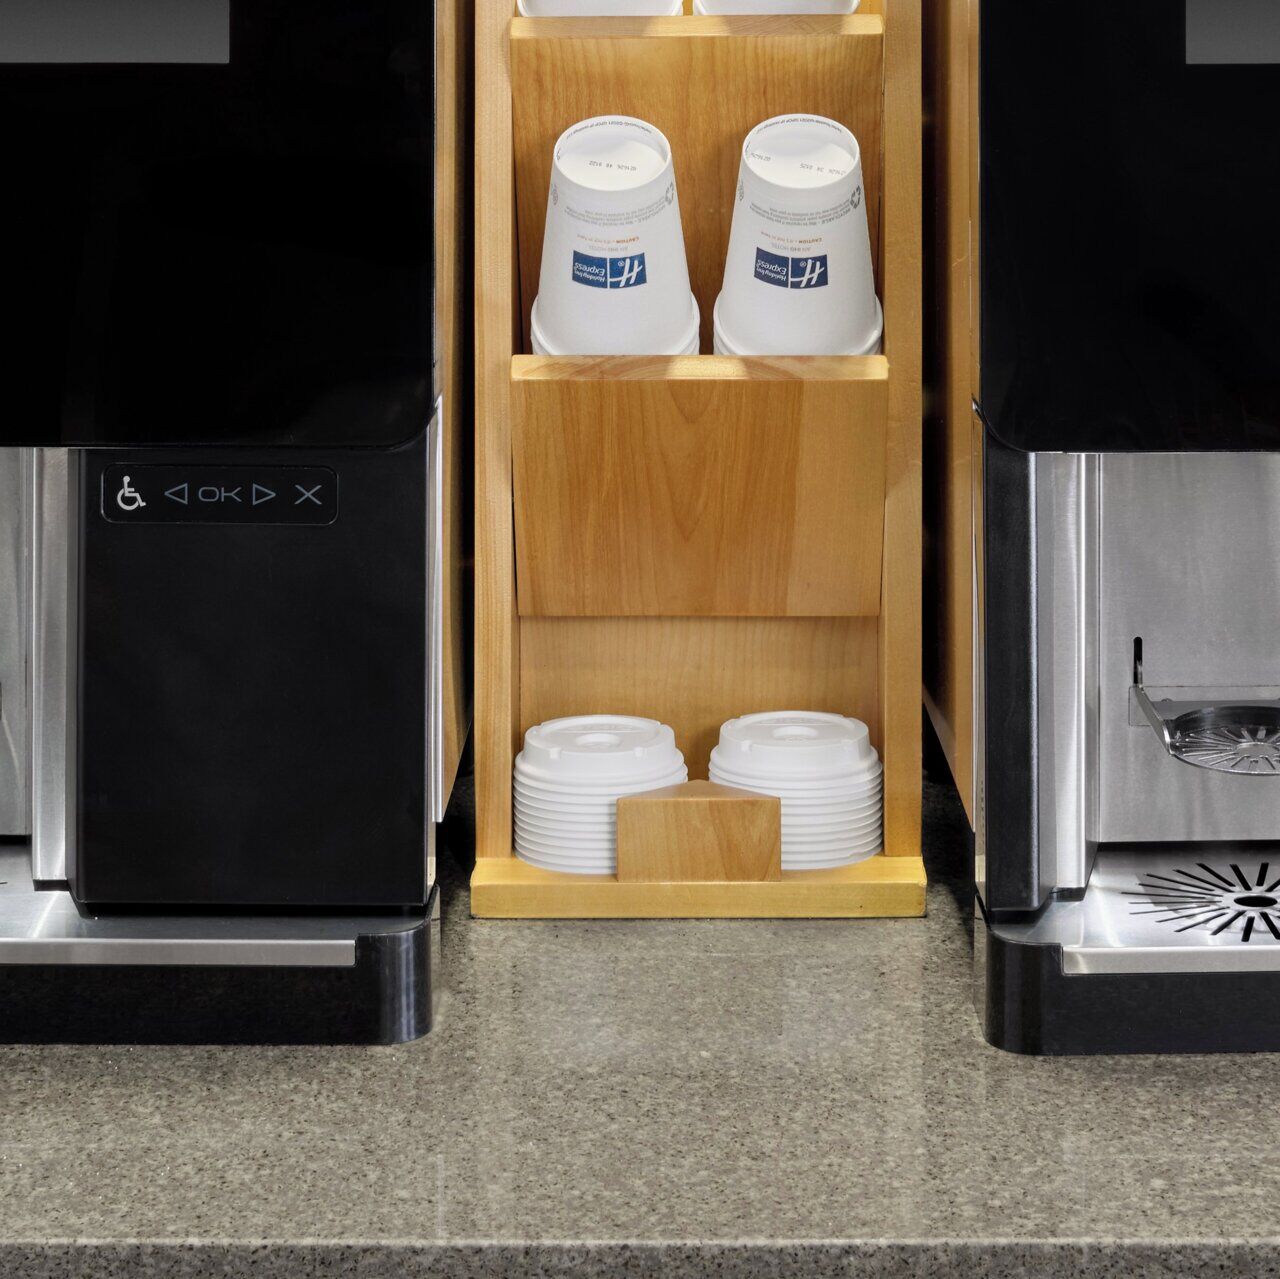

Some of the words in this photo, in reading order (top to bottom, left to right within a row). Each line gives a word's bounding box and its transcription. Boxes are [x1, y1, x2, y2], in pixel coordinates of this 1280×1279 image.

[575, 263, 605, 276] Express
[757, 260, 786, 274] Express
[198, 487, 241, 501] OK
